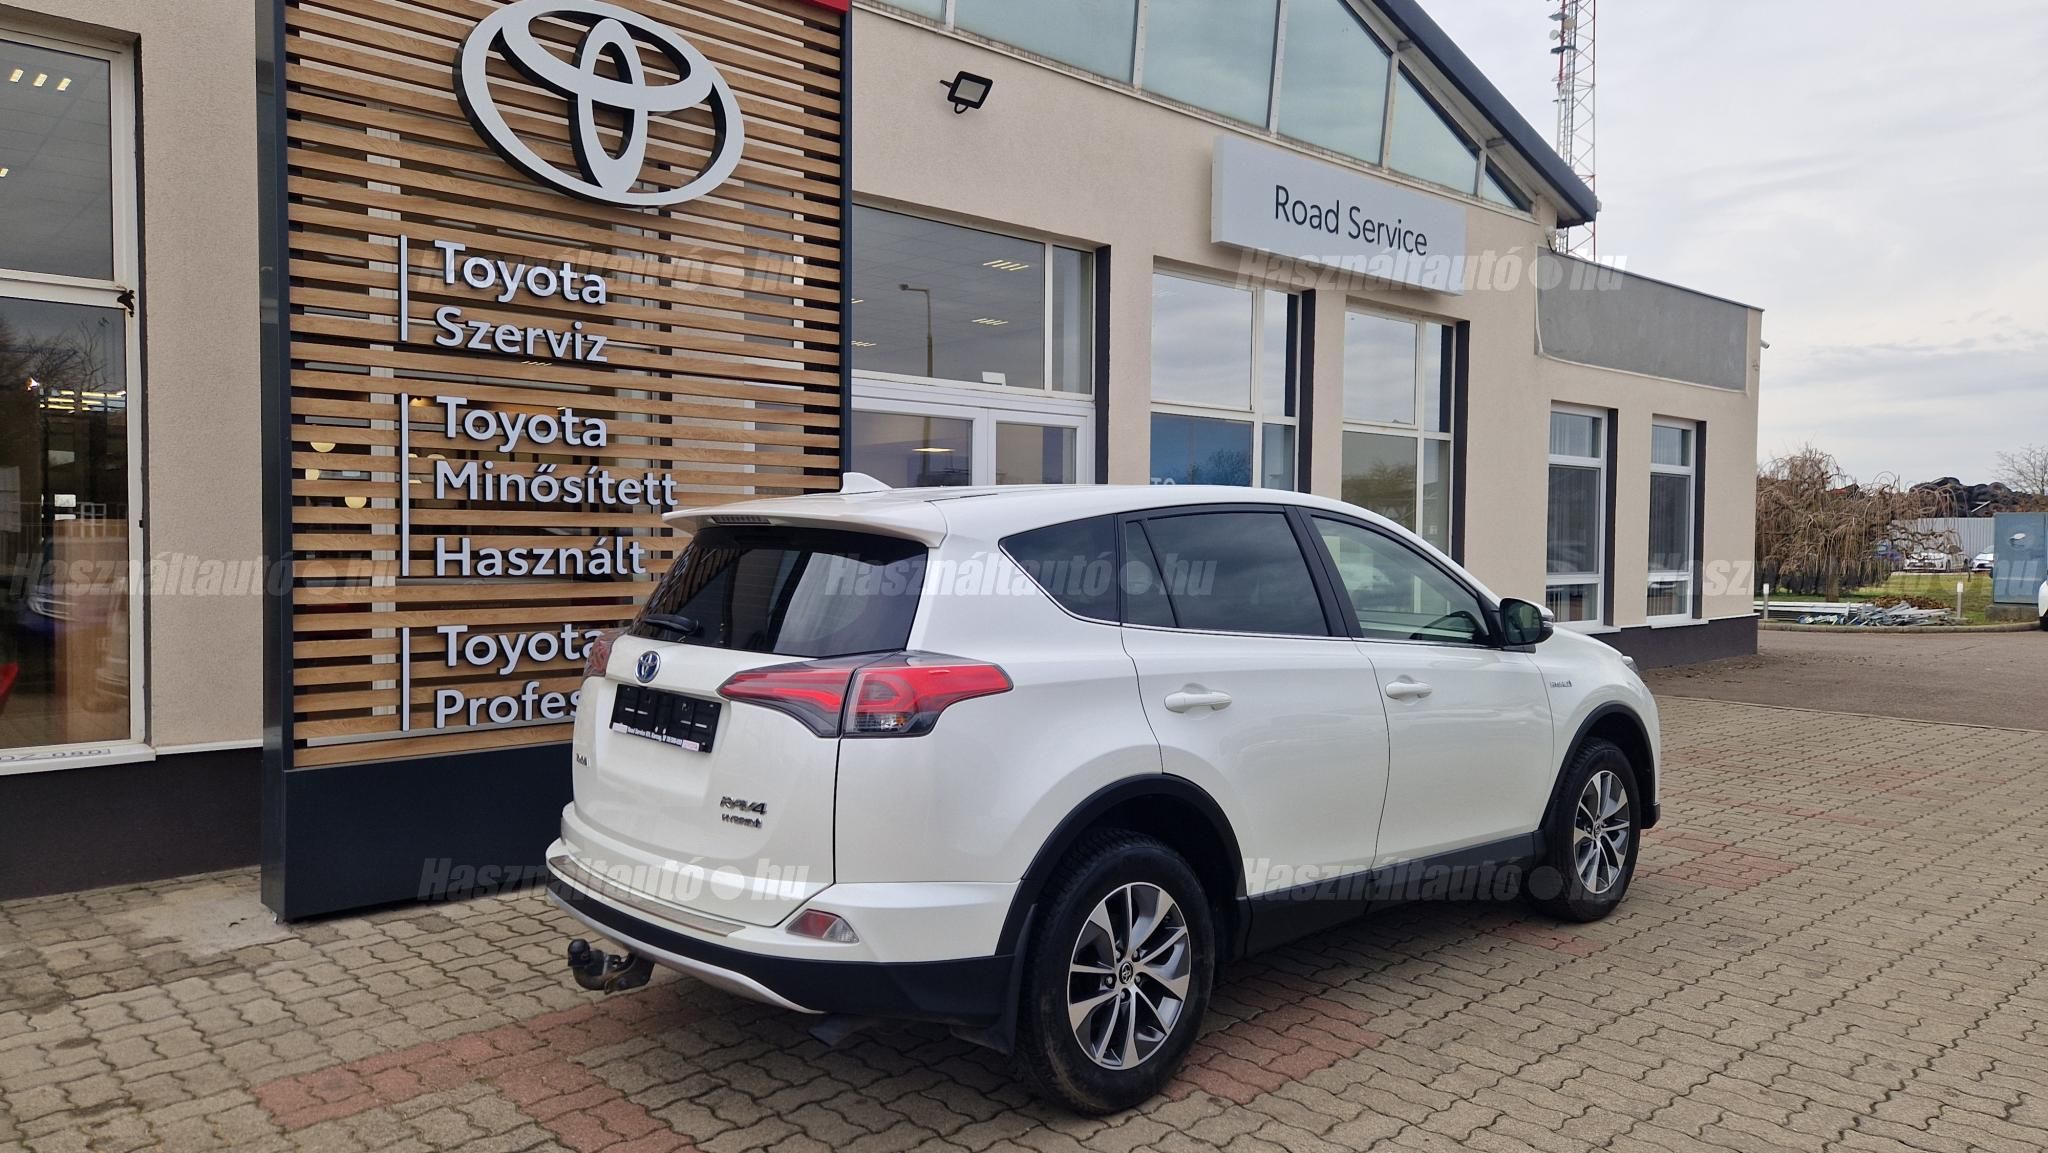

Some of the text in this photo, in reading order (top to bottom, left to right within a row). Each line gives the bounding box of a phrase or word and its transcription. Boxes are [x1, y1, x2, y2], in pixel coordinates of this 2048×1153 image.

[1275, 184, 1428, 257] Road Service
[434, 240, 607, 304] Toyota
[435, 307, 608, 363] Szerviz
[436, 395, 608, 452] Toyota
[436, 460, 678, 507] Minősített
[436, 537, 646, 577] Használt
